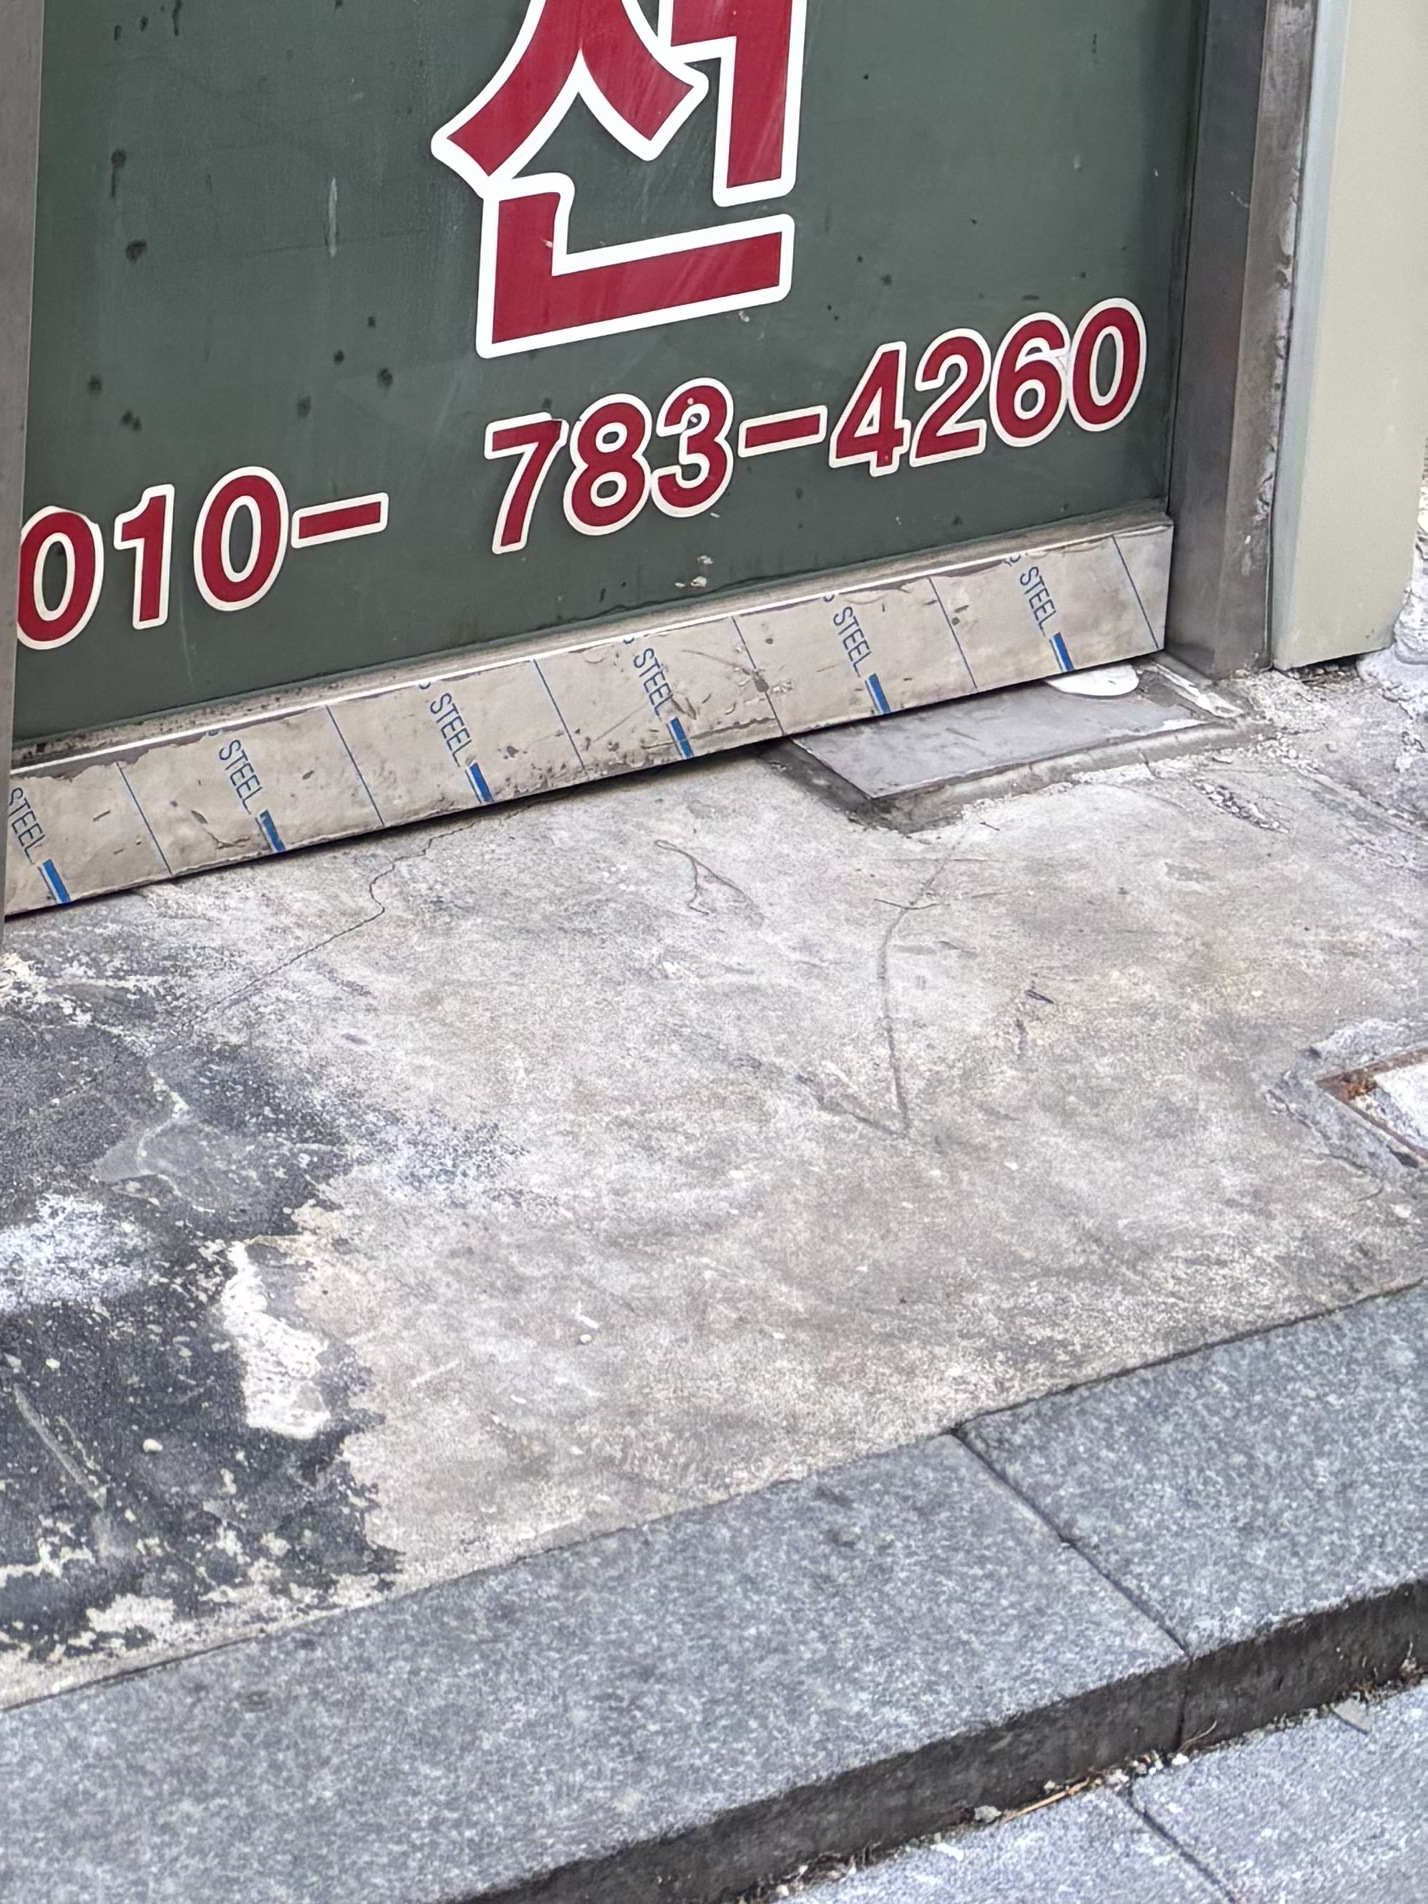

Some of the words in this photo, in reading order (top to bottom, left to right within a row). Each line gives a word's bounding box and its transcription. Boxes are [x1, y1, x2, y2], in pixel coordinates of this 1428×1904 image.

[14, 465, 389, 652] 010-
[484, 296, 1148, 555] 783-4260
[1018, 565, 1058, 633] STEEL
[831, 605, 877, 678] STEEL
[631, 646, 676, 719] STEEL
[428, 691, 474, 769] STEEL
[217, 738, 266, 815] STEEL
